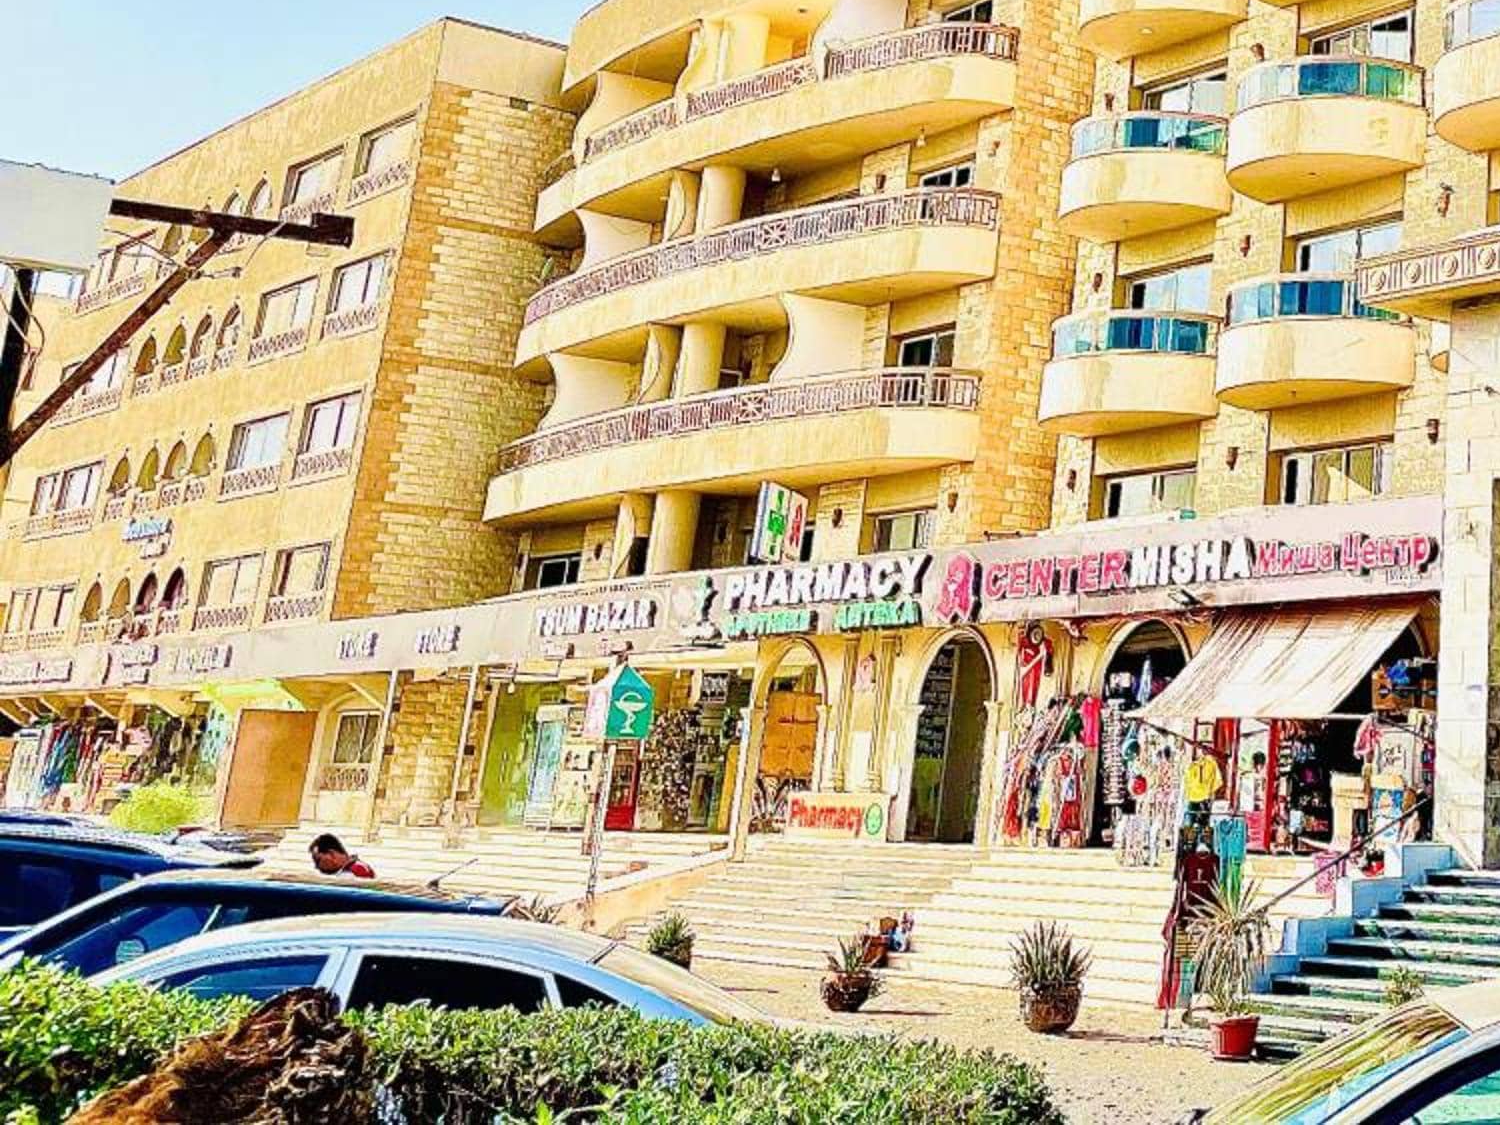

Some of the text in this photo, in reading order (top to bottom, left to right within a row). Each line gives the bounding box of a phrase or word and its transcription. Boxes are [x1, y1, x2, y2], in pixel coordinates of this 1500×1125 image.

[984, 536, 1252, 599] CENTER MISHA
[1255, 532, 1431, 576] Миша Центр
[725, 555, 930, 611] PHARMACY
[586, 600, 655, 633] BAZAR
[789, 798, 864, 838] Pharmacy
